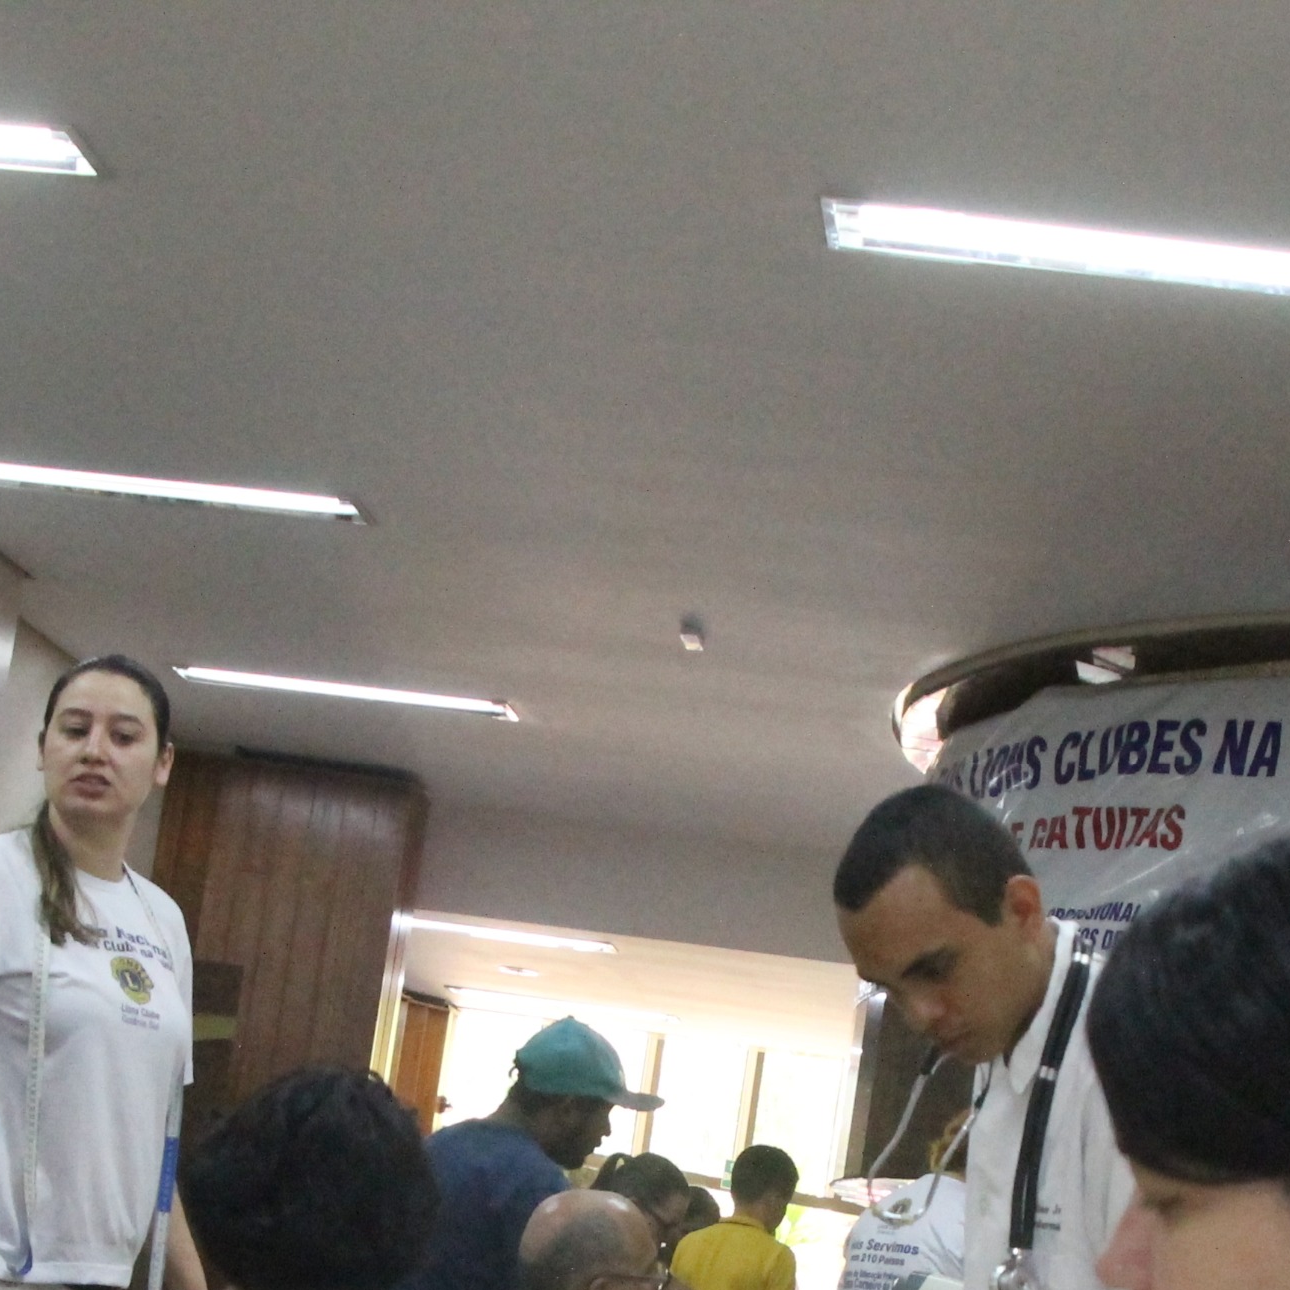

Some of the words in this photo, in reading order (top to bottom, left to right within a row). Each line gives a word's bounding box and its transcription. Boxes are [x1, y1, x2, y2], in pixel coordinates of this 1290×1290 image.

[1054, 718, 1207, 785] CLUBES
[1212, 719, 1282, 777] NA
[866, 1238, 920, 1255] Servimos
